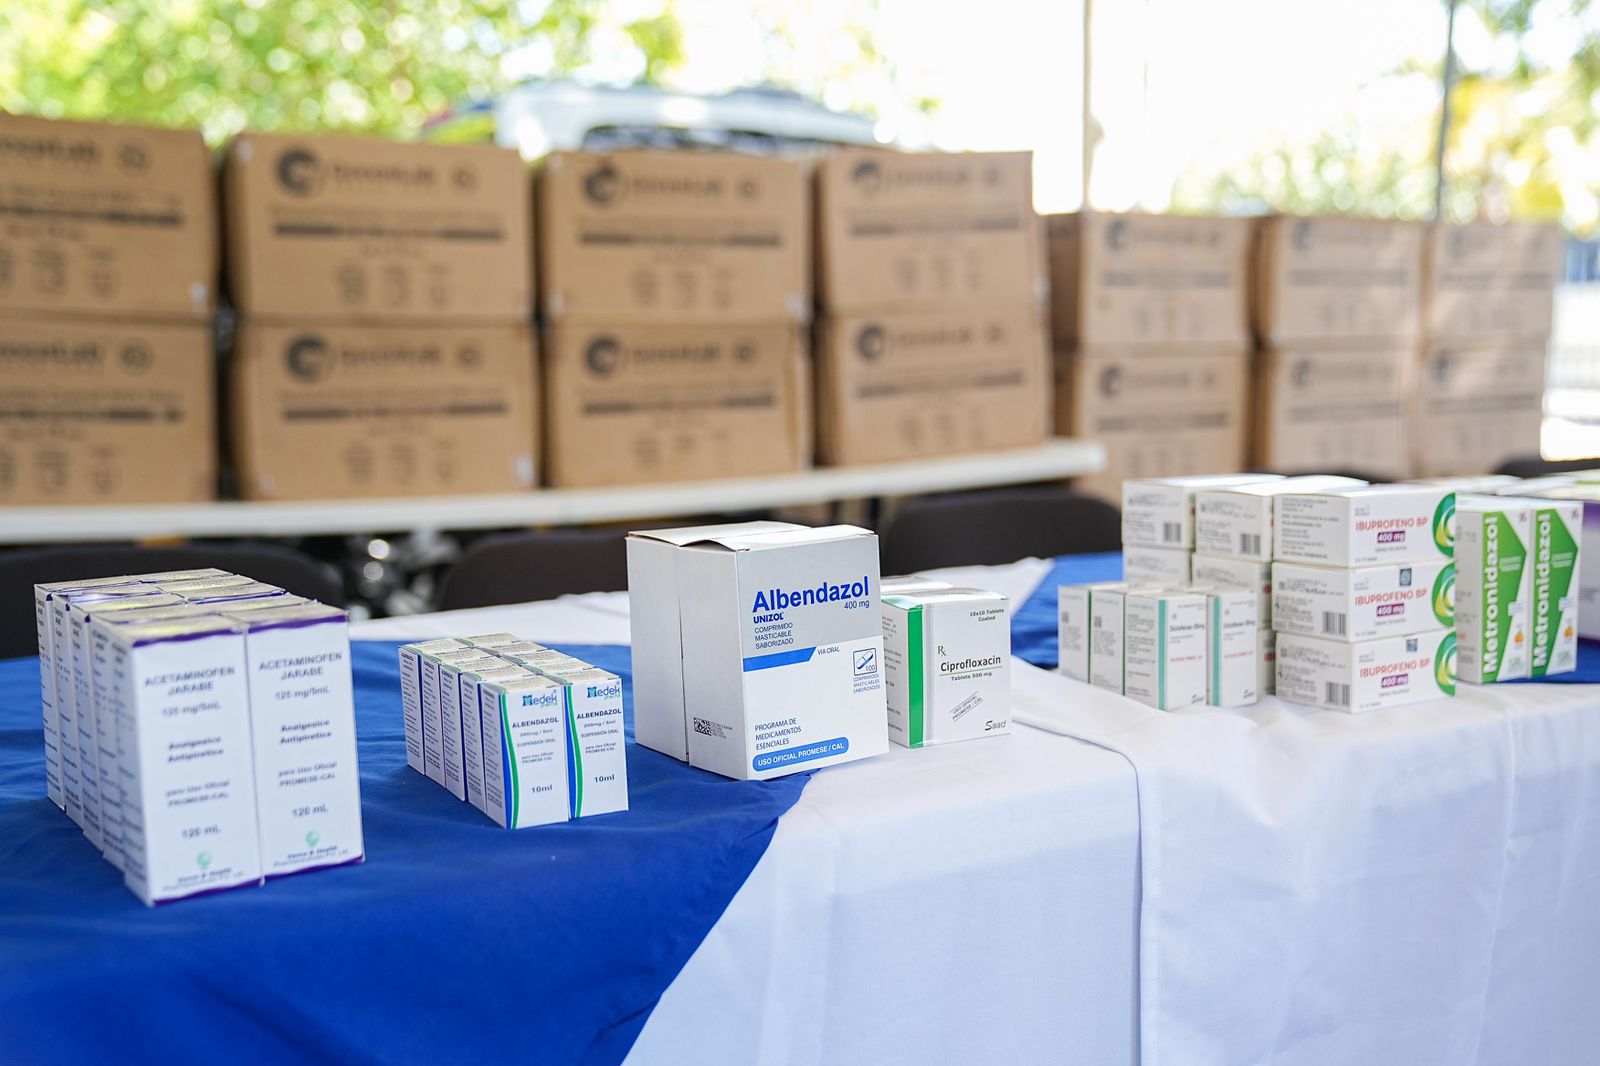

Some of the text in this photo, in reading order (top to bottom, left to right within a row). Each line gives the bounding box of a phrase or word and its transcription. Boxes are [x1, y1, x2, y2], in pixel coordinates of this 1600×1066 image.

[1355, 516, 1428, 531] IBUPROFENO BP
[1378, 533, 1393, 542] 400
[752, 576, 869, 613] Albendazol
[1355, 587, 1427, 606] IBUPROFENO BP
[1484, 516, 1498, 673] Metronidazol
[1534, 513, 1550, 668] Metronidazol
[844, 600, 870, 610] 400 mg
[1378, 605, 1393, 616] 400
[754, 622, 794, 634] COMPRIMIDO
[754, 630, 792, 642] MASTICABLE
[755, 638, 794, 650] SABORIZADO
[259, 653, 342, 671] ACETAMINOFEN
[865, 664, 876, 672] 100
[940, 655, 1001, 673] Ciprofloxacin
[1360, 657, 1431, 678] IBUPROFENO BP
[144, 666, 234, 687] ACETAMINOFEN
[281, 666, 322, 680] JARABE
[853, 673, 880, 683] COMPRIMIDOS
[168, 680, 213, 695] JARABE
[853, 679, 880, 688] MASTICABLES
[853, 684, 881, 694] SABORIZADOS
[576, 709, 621, 719] ALBENDAZOL
[512, 717, 559, 728] ALBENDAZOL
[754, 717, 797, 732] PROGRAMA DE
[755, 726, 802, 742] MEDICAMENTOS
[755, 737, 790, 751] ESENCIALES
[758, 757, 773, 767] USO
[773, 753, 798, 764] OFICIAL
[798, 747, 828, 760] PROMESE
[832, 742, 845, 752] CAL
[594, 774, 614, 782] 10ml
[531, 785, 552, 793] 10ml
